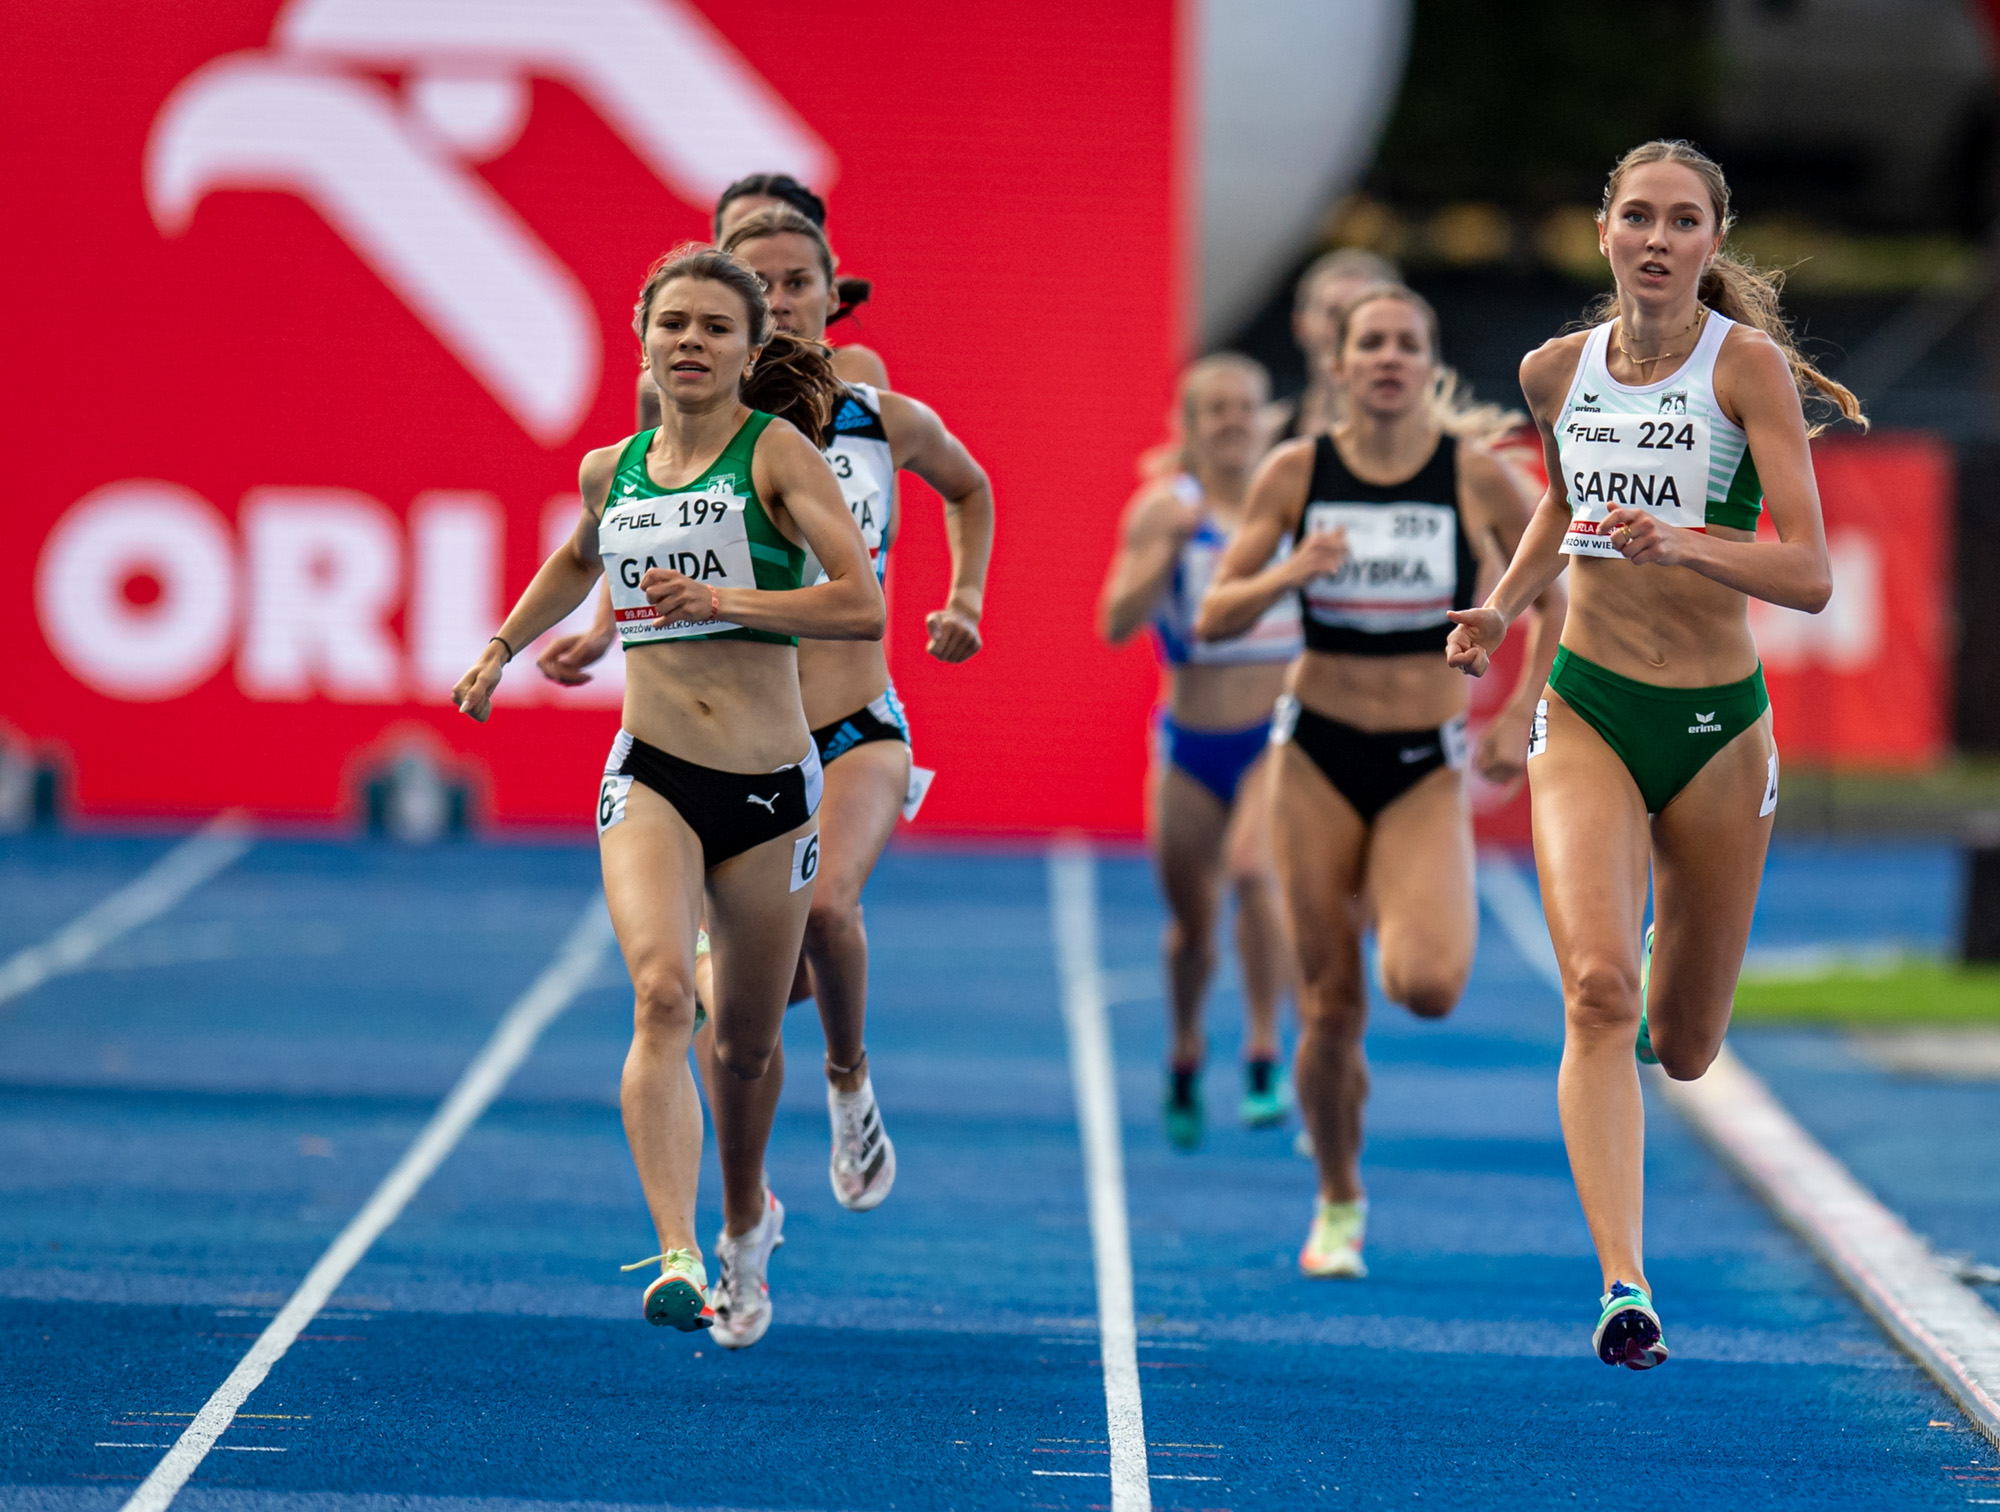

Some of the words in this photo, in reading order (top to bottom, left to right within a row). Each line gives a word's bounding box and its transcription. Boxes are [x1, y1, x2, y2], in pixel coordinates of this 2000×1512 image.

[1575, 427, 1621, 443] FUEL
[1636, 421, 1695, 451] 224
[1574, 471, 1682, 508] SARNA
[618, 513, 662, 531] FUEL
[678, 499, 728, 527] 199
[1688, 722, 1722, 734] erima
[600, 778, 618, 827] 6
[801, 834, 818, 881] 6
